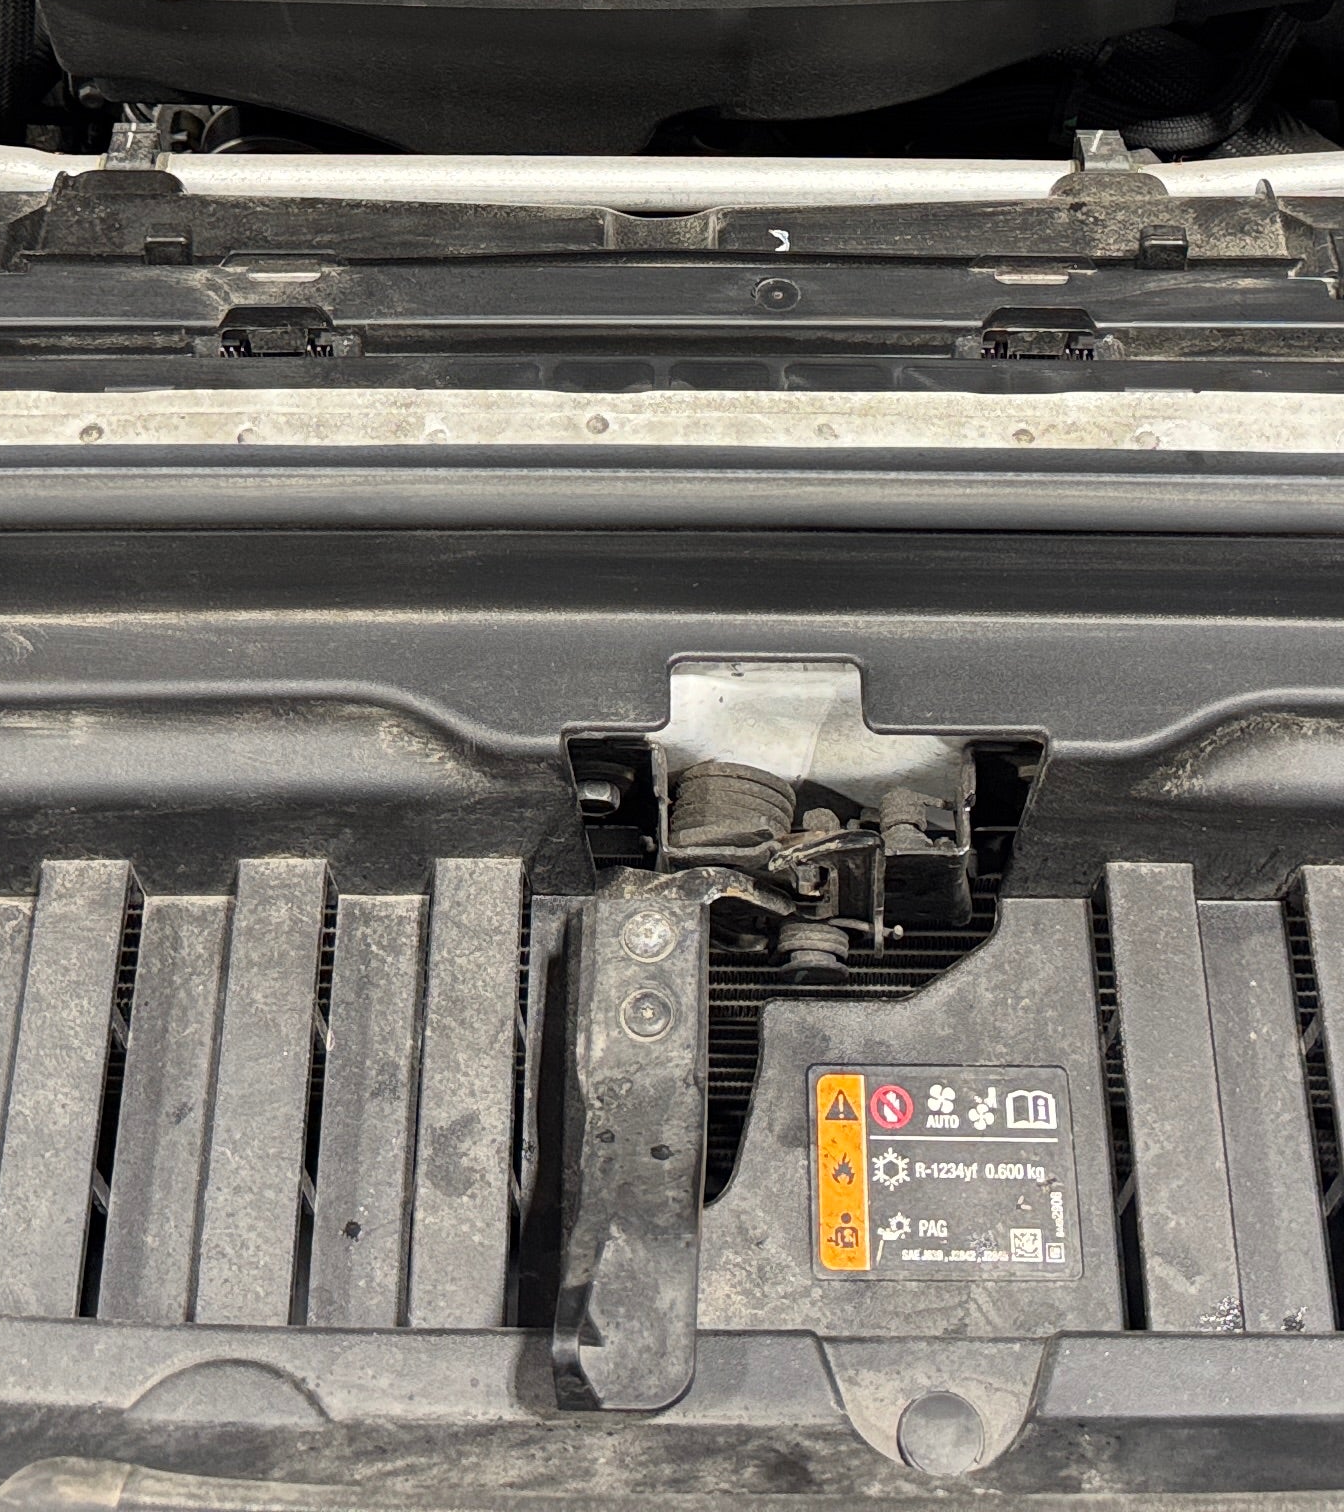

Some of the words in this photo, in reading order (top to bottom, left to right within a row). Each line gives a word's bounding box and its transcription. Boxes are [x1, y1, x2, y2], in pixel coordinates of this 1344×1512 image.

[926, 1114, 960, 1129] AUTO
[915, 1162, 978, 1182] R-1234yf
[984, 1163, 1024, 1180] 0.600
[1026, 1163, 1045, 1183] kg
[918, 1220, 948, 1238] PAG
